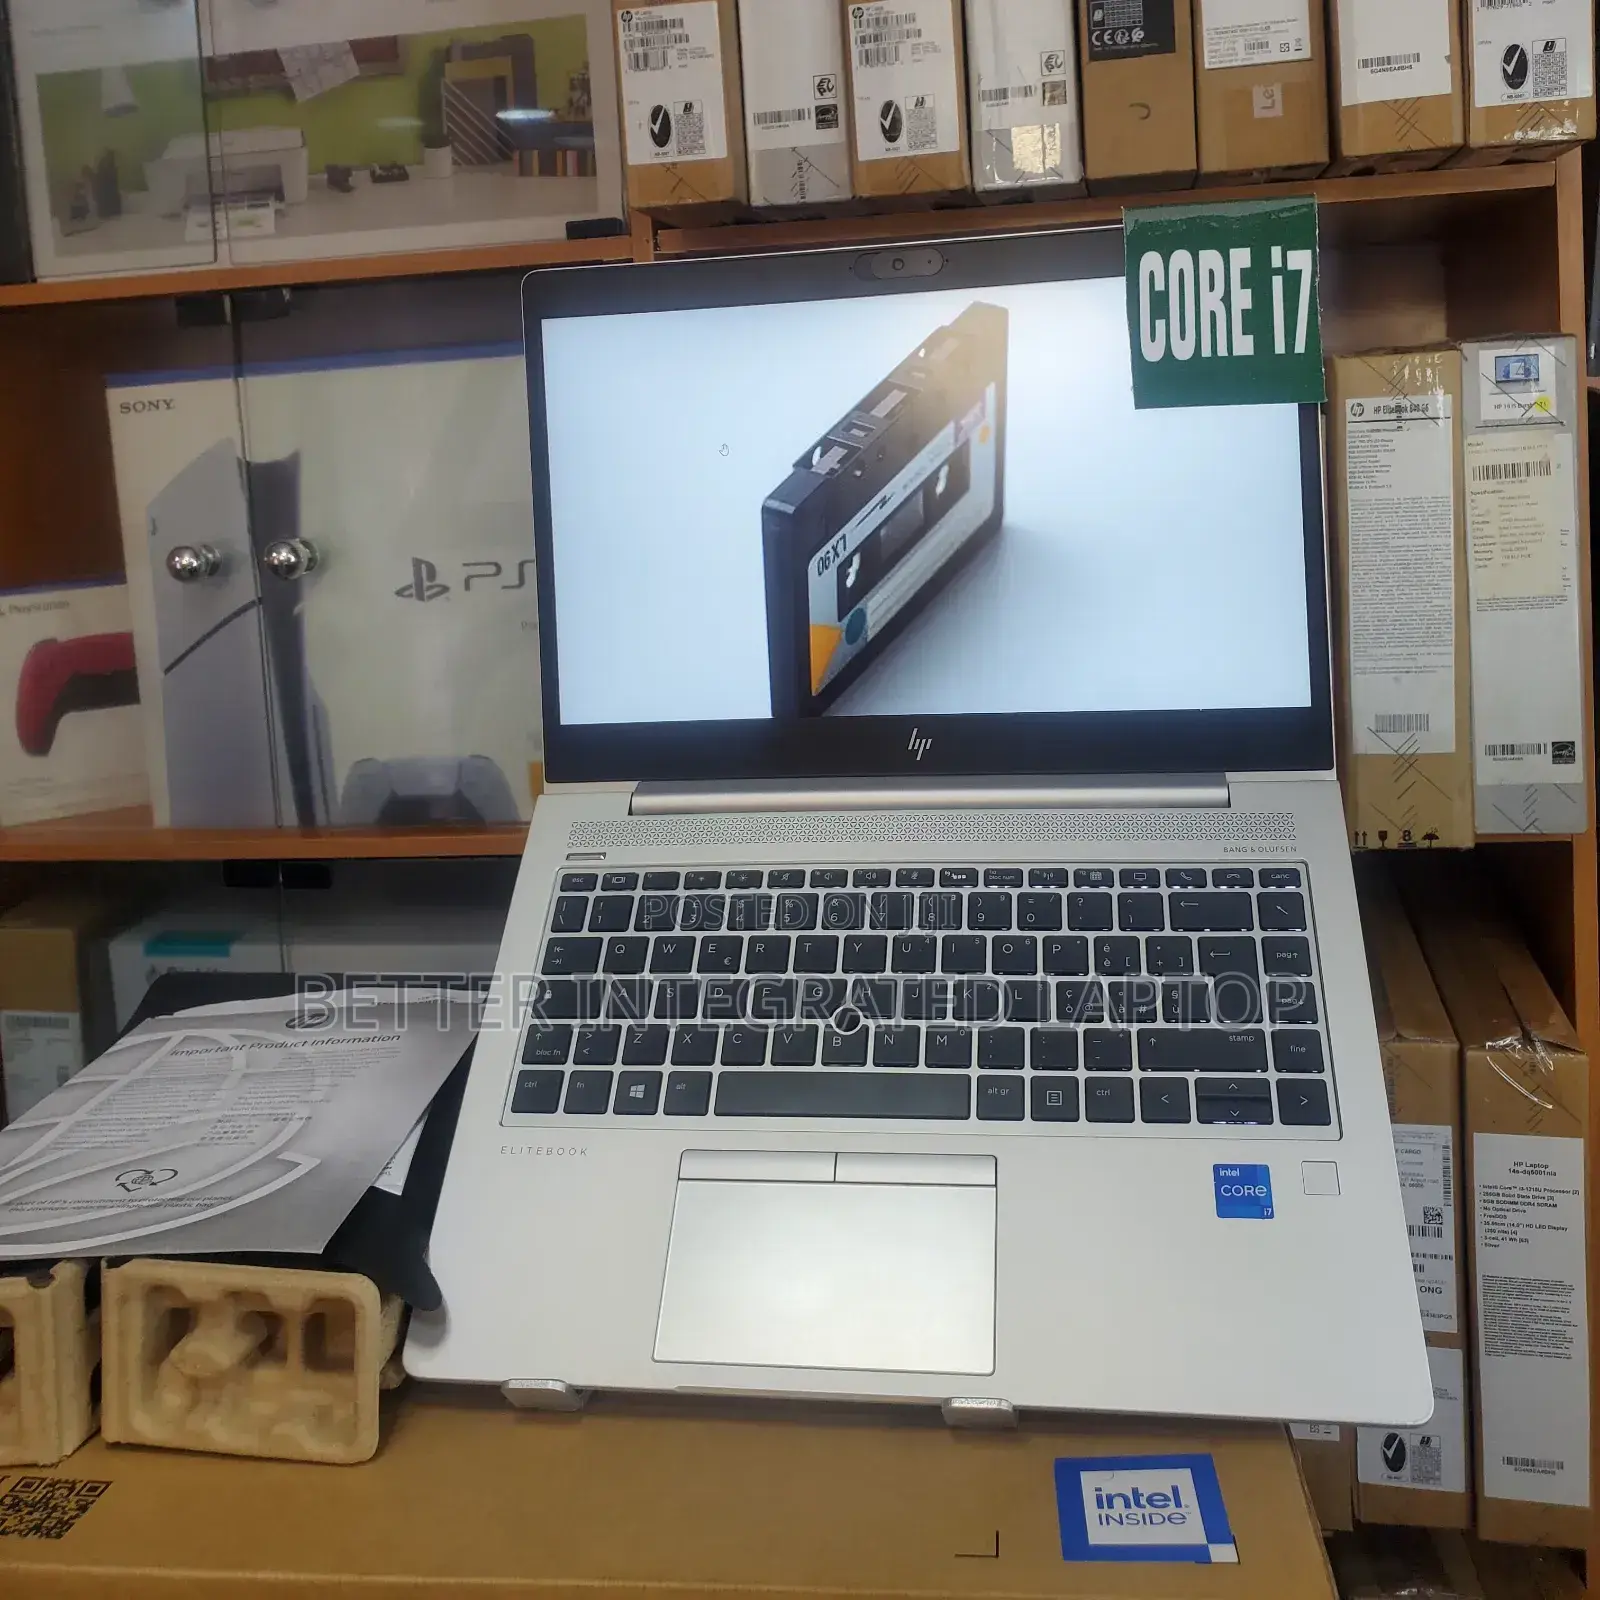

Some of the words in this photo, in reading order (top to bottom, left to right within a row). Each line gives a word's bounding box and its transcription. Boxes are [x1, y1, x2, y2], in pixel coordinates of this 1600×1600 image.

[1139, 247, 1255, 362] CORE
[1271, 246, 1313, 355] i7
[119, 398, 175, 415] SONY
[1373, 406, 1382, 415] HP
[907, 727, 932, 761] hp
[1402, 829, 1411, 842] 8
[1257, 845, 1297, 853] OLUFSEN
[785, 899, 794, 908] %
[1077, 897, 1084, 906] ?
[690, 914, 697, 923] 3
[784, 914, 791, 923] 5
[831, 913, 838, 922] 6
[928, 913, 935, 922] 8
[977, 913, 985, 922] 9
[615, 944, 626, 955] Q
[662, 944, 677, 954] W
[708, 944, 717, 953] E
[755, 944, 765, 953] R
[803, 943, 812, 953] T
[853, 943, 863, 953] Y
[902, 943, 911, 953] U
[1002, 943, 1013, 953] O
[1052, 944, 1061, 954] P
[1103, 944, 1111, 953] é
[724, 956, 732, 966] €
[1103, 957, 1111, 967] è
[618, 988, 628, 998] A
[666, 988, 674, 998] S
[714, 988, 724, 997] D
[762, 988, 771, 997] F
[812, 987, 823, 997] G
[861, 988, 871, 997] H
[912, 988, 919, 998] J
[963, 989, 973, 999] K
[1014, 989, 1023, 1000] L
[1083, 1003, 1093, 1013] @
[1138, 1004, 1147, 1014] #
[633, 1034, 643, 1043] Z
[682, 1033, 692, 1043] X
[732, 1033, 743, 1044] C
[783, 1034, 793, 1044] V
[832, 1037, 842, 1047] B
[884, 1035, 894, 1045] N
[936, 1036, 948, 1046] M
[1228, 1034, 1255, 1042] stamp
[170, 1043, 245, 1056] Important
[249, 1039, 308, 1051] Product
[310, 1034, 401, 1047] Information
[1290, 1045, 1306, 1053] fine
[524, 1080, 538, 1089] ctrl
[576, 1081, 585, 1089] fn
[675, 1082, 686, 1090] alt
[987, 1087, 998, 1095] alt
[1000, 1087, 1010, 1096] gr
[1096, 1088, 1111, 1097] ctrl
[500, 1146, 588, 1156] ELITEBOOK
[1525, 1161, 1549, 1169] Laptop
[1219, 1167, 1240, 1177] intel
[1543, 1187, 1571, 1195] Processor
[1263, 1208, 1272, 1216] i7
[1547, 1224, 1569, 1232] Display
